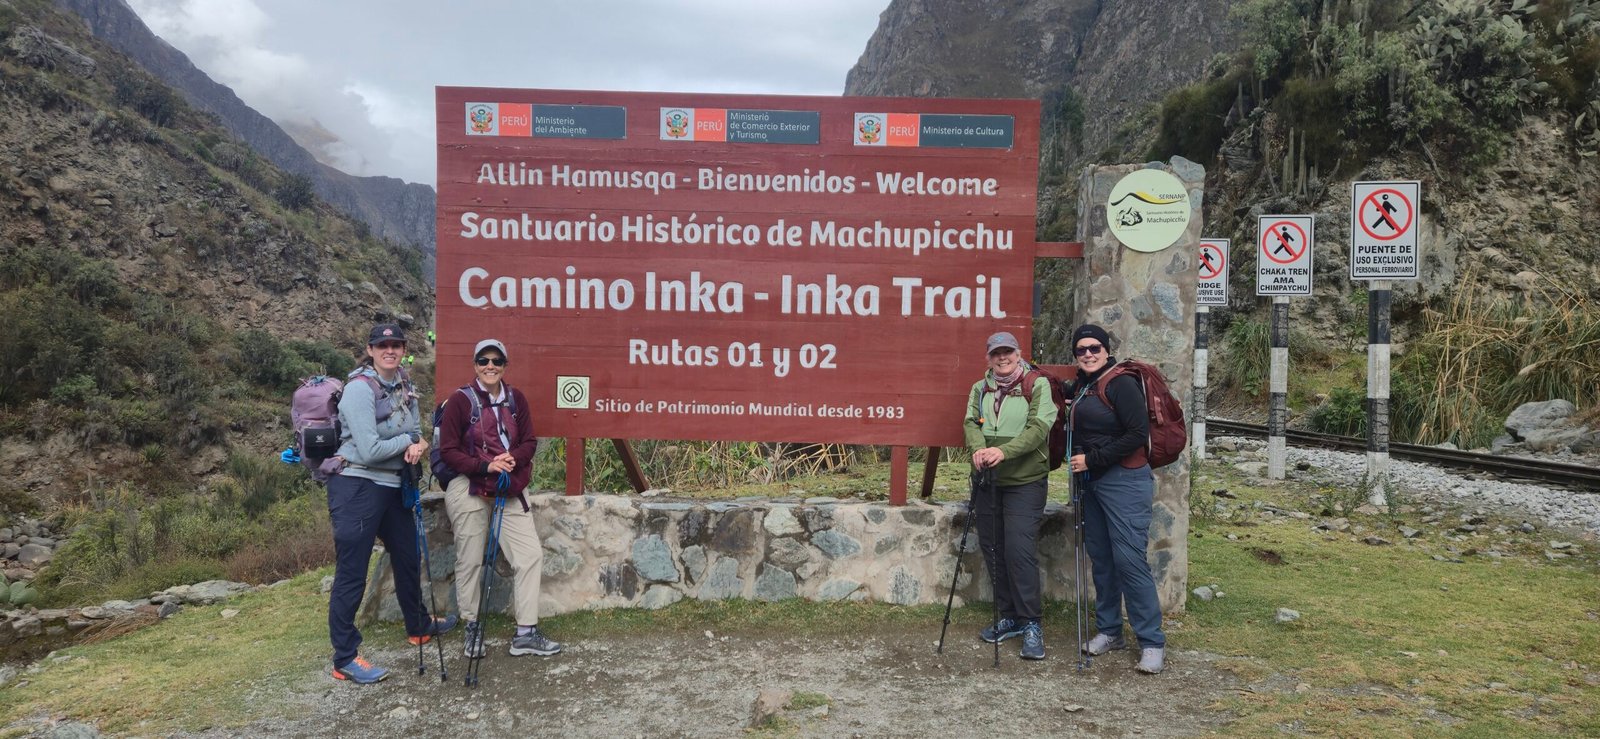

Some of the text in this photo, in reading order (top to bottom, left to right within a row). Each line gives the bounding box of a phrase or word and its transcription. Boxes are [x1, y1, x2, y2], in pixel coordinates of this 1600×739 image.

[501, 114, 528, 126] PERÚ
[535, 116, 575, 125] Ministerio
[730, 112, 769, 121] Ministerio
[549, 126, 587, 134] Ambiente
[697, 120, 723, 131] PERÚ
[741, 122, 778, 130] Comercio
[780, 123, 810, 131] Exterior
[889, 124, 915, 136] PERÚ
[736, 131, 767, 139] Turismo
[923, 126, 1004, 136] Ministerio de Cultura
[477, 162, 544, 187] Allin
[552, 165, 676, 195] Hamusqa
[698, 167, 856, 194] Bienvenidos
[876, 171, 997, 197] Welcome
[461, 212, 1013, 256] Santuario Histórico de Machupicchu
[1358, 245, 1397, 254] PUENTE
[1356, 256, 1413, 264] USO EXCLUSIVO
[459, 266, 635, 311] Camino
[645, 271, 744, 314] Inka
[781, 274, 880, 317] Inka
[893, 274, 1007, 319] Trail
[629, 338, 837, 378] Rutas 01 y 02
[595, 399, 905, 419] Sitio de Patrimonio Mundial desde 1983
